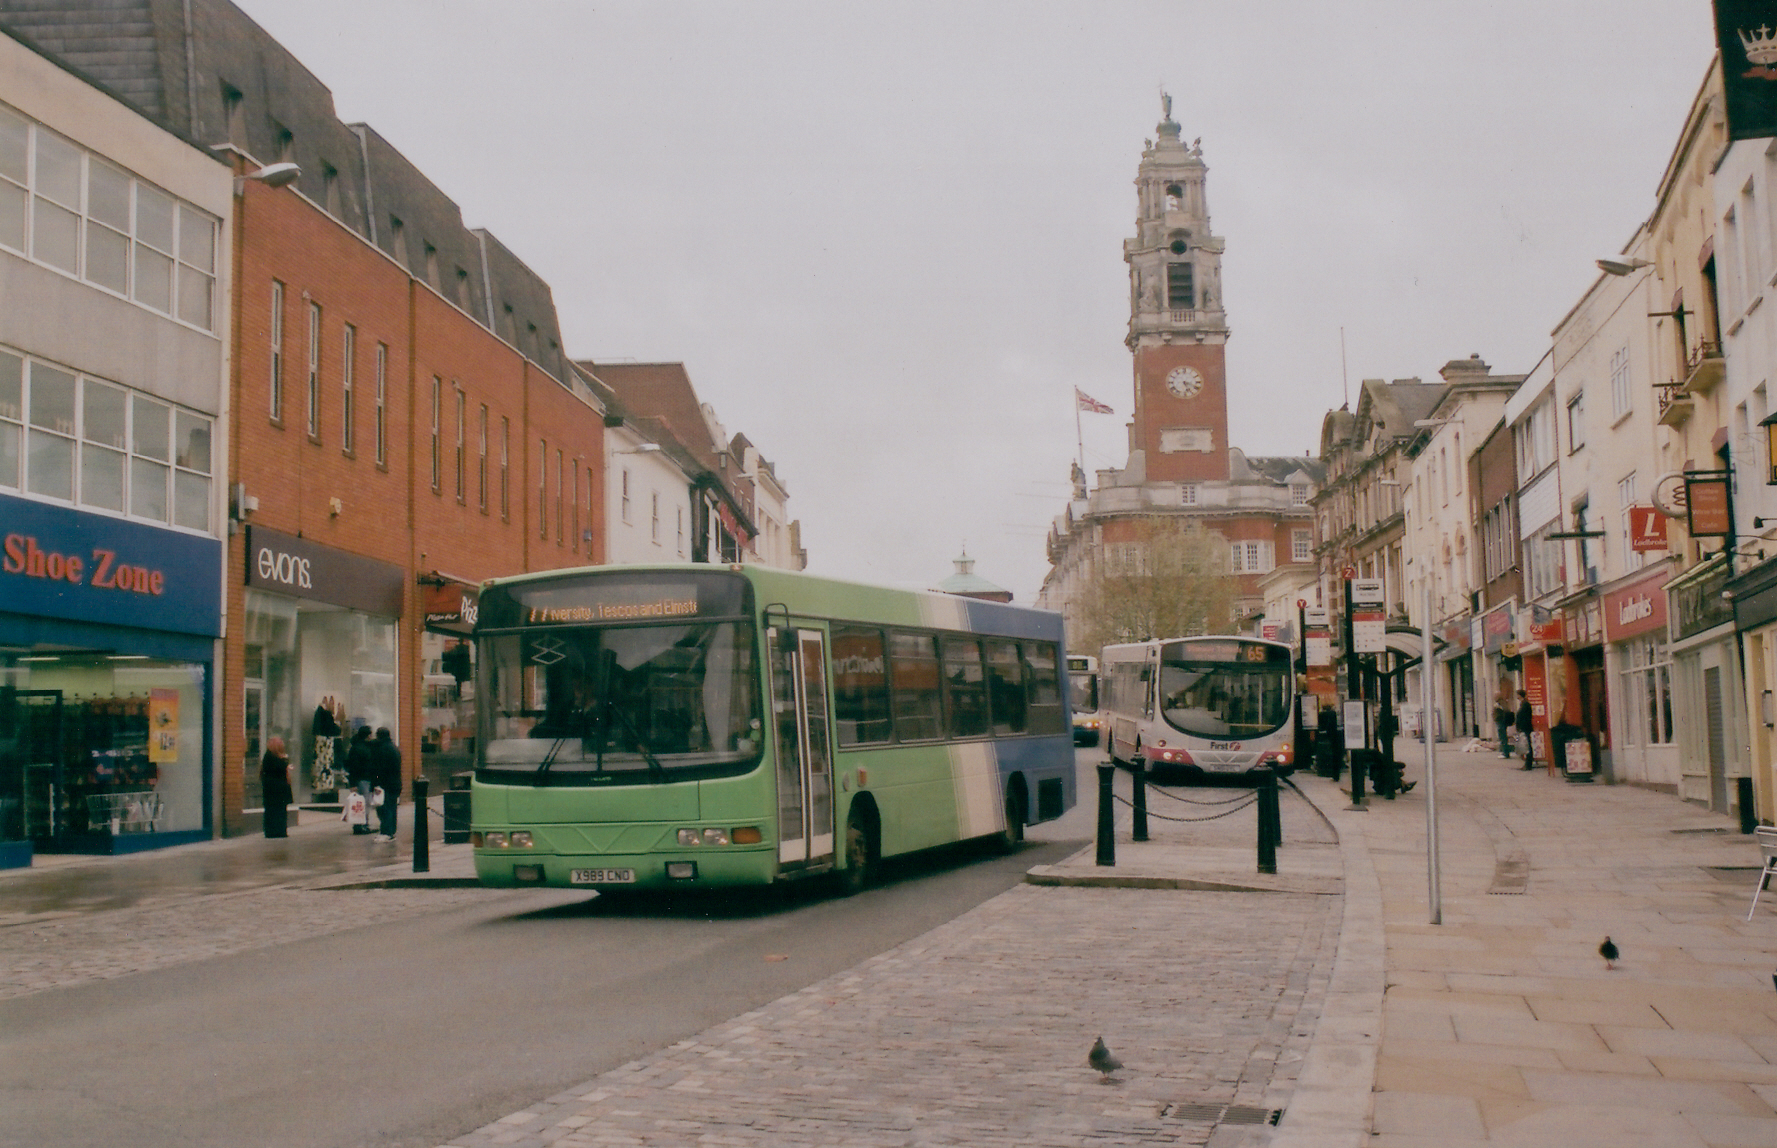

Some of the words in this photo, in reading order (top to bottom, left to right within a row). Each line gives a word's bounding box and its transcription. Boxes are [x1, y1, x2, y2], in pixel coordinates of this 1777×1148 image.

[1644, 513, 1660, 537] L
[3, 533, 84, 583] Shoe
[90, 549, 165, 596] Zone
[1345, 569, 1352, 577] Z
[1247, 646, 1264, 661] 65
[1210, 741, 1229, 751] First
[576, 870, 605, 881] X989
[607, 869, 630, 881] CNO
